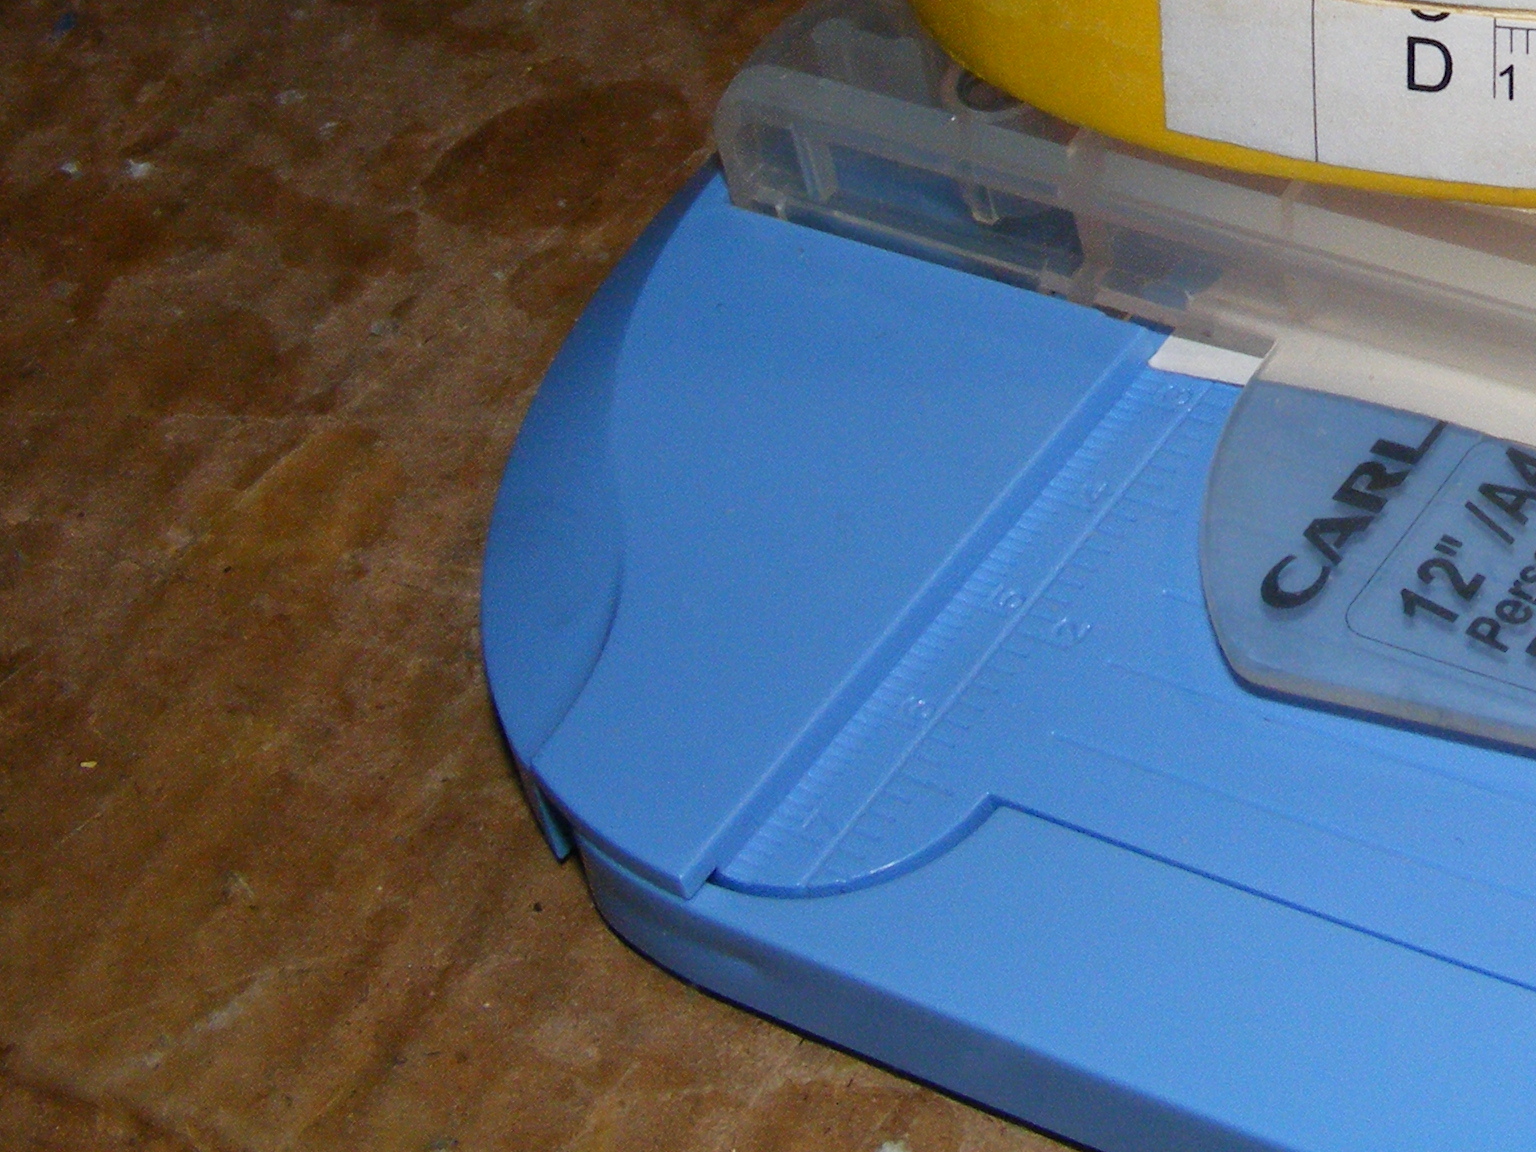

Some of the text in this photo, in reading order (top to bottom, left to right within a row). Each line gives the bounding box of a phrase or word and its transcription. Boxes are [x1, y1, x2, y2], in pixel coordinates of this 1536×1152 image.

[1406, 34, 1454, 94] D
[1498, 64, 1515, 101] 1
[1259, 419, 1449, 611] CARL
